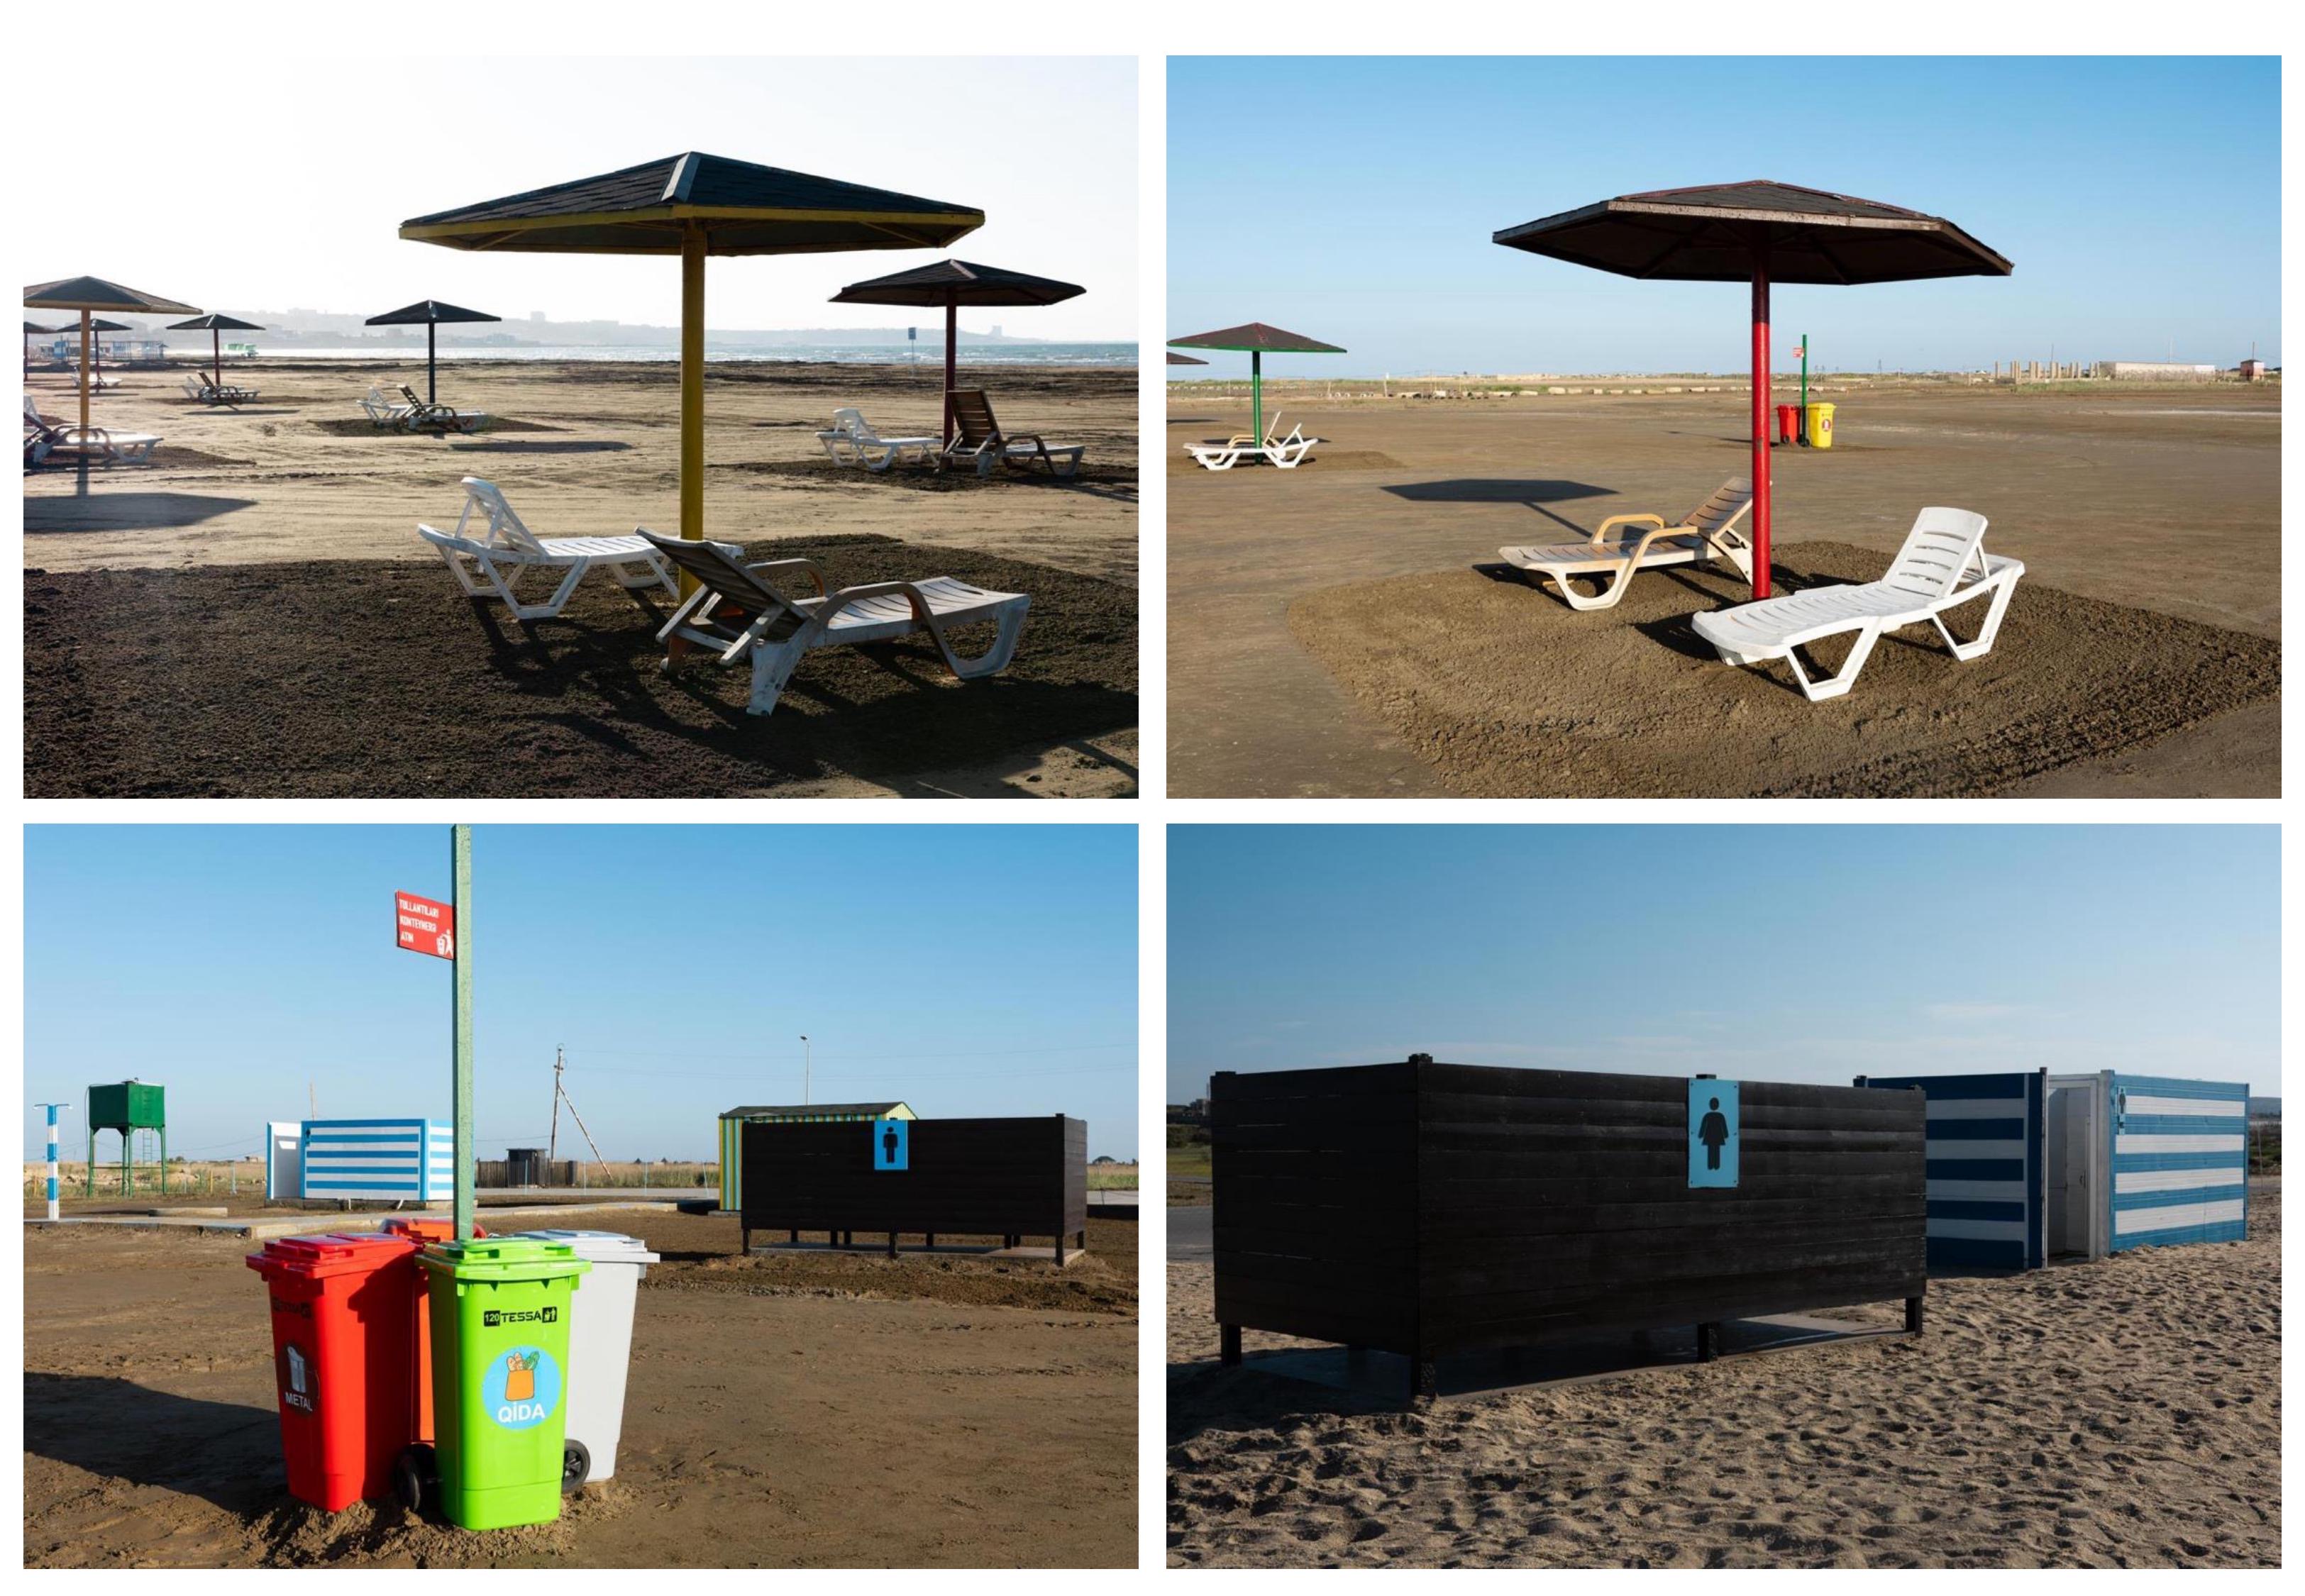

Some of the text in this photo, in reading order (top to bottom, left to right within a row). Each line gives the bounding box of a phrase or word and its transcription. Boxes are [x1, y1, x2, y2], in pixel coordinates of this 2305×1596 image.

[485, 1311, 541, 1322] 120 TESSA
[285, 1392, 313, 1412] METAL
[498, 1402, 546, 1423] QİDA
